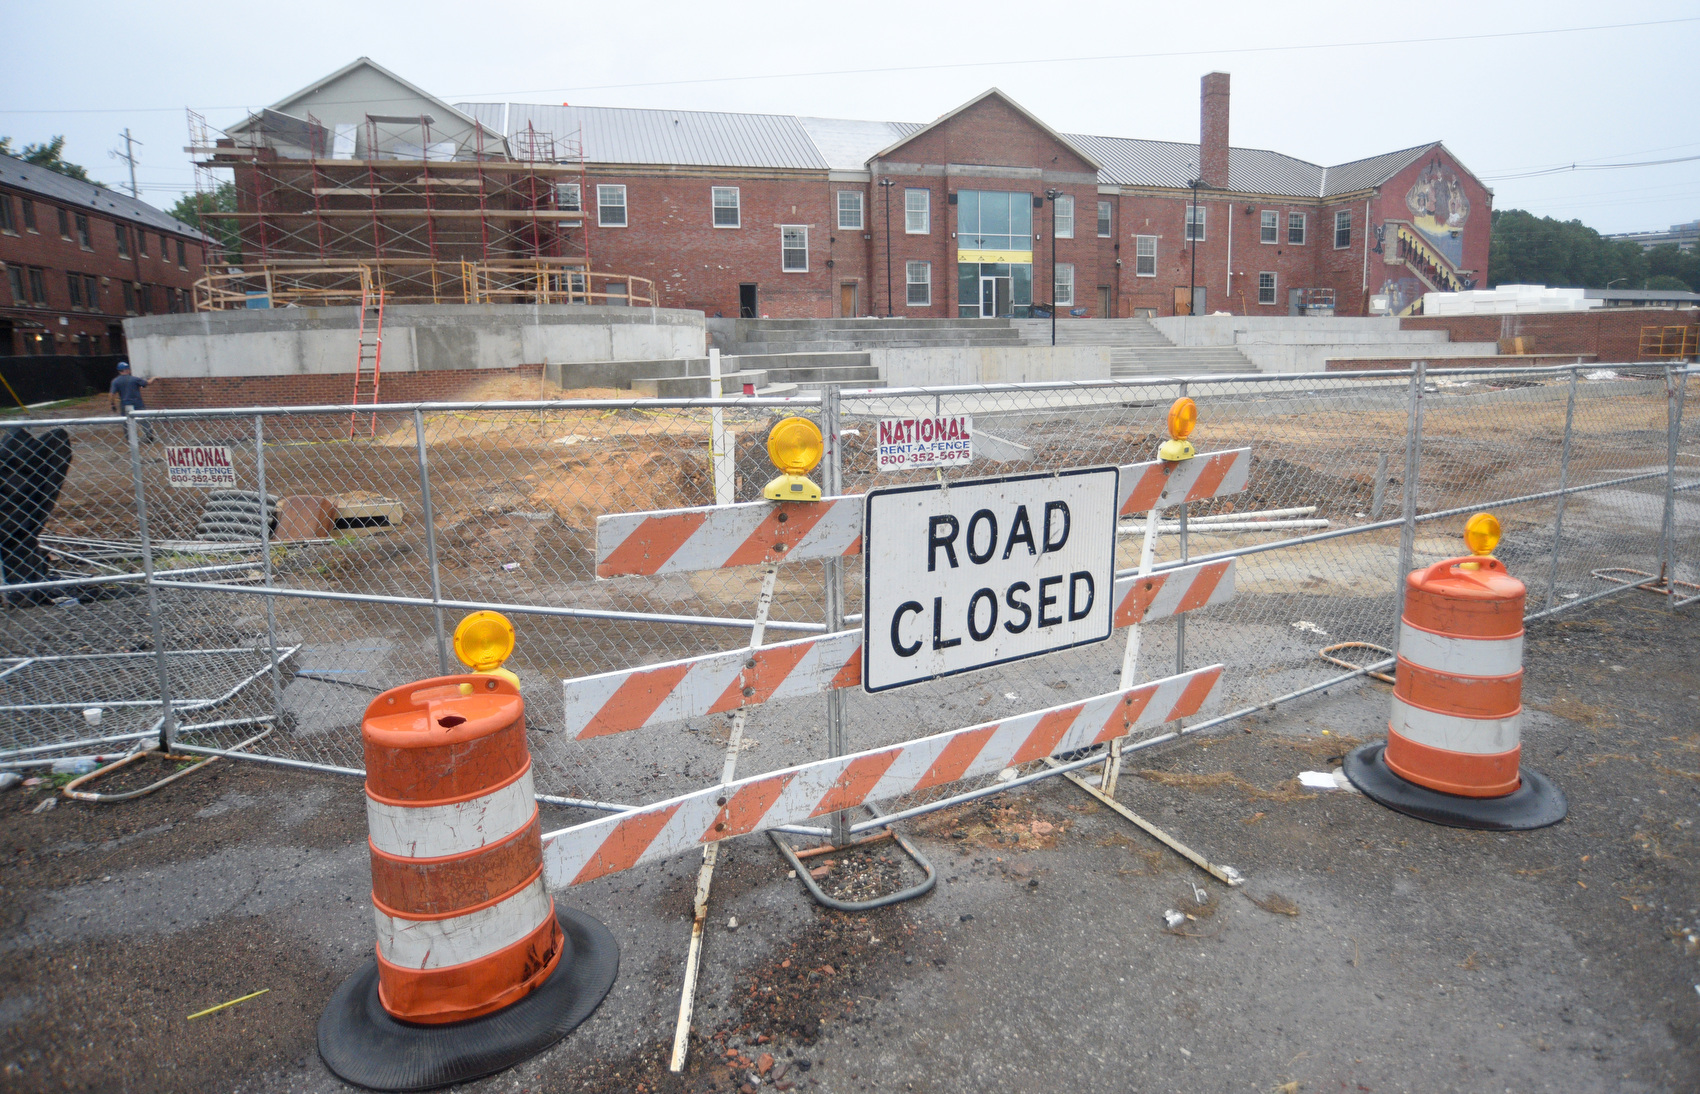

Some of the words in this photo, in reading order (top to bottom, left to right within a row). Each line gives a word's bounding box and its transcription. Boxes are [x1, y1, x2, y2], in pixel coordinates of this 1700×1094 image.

[880, 417, 970, 445] NATIONAL
[167, 448, 230, 467] NATIONAL
[880, 441, 970, 455] RENT-A-FENCE
[881, 450, 970, 465] 800-352-5675
[928, 500, 1071, 572] ROAD
[890, 570, 1095, 657] CLOSED
